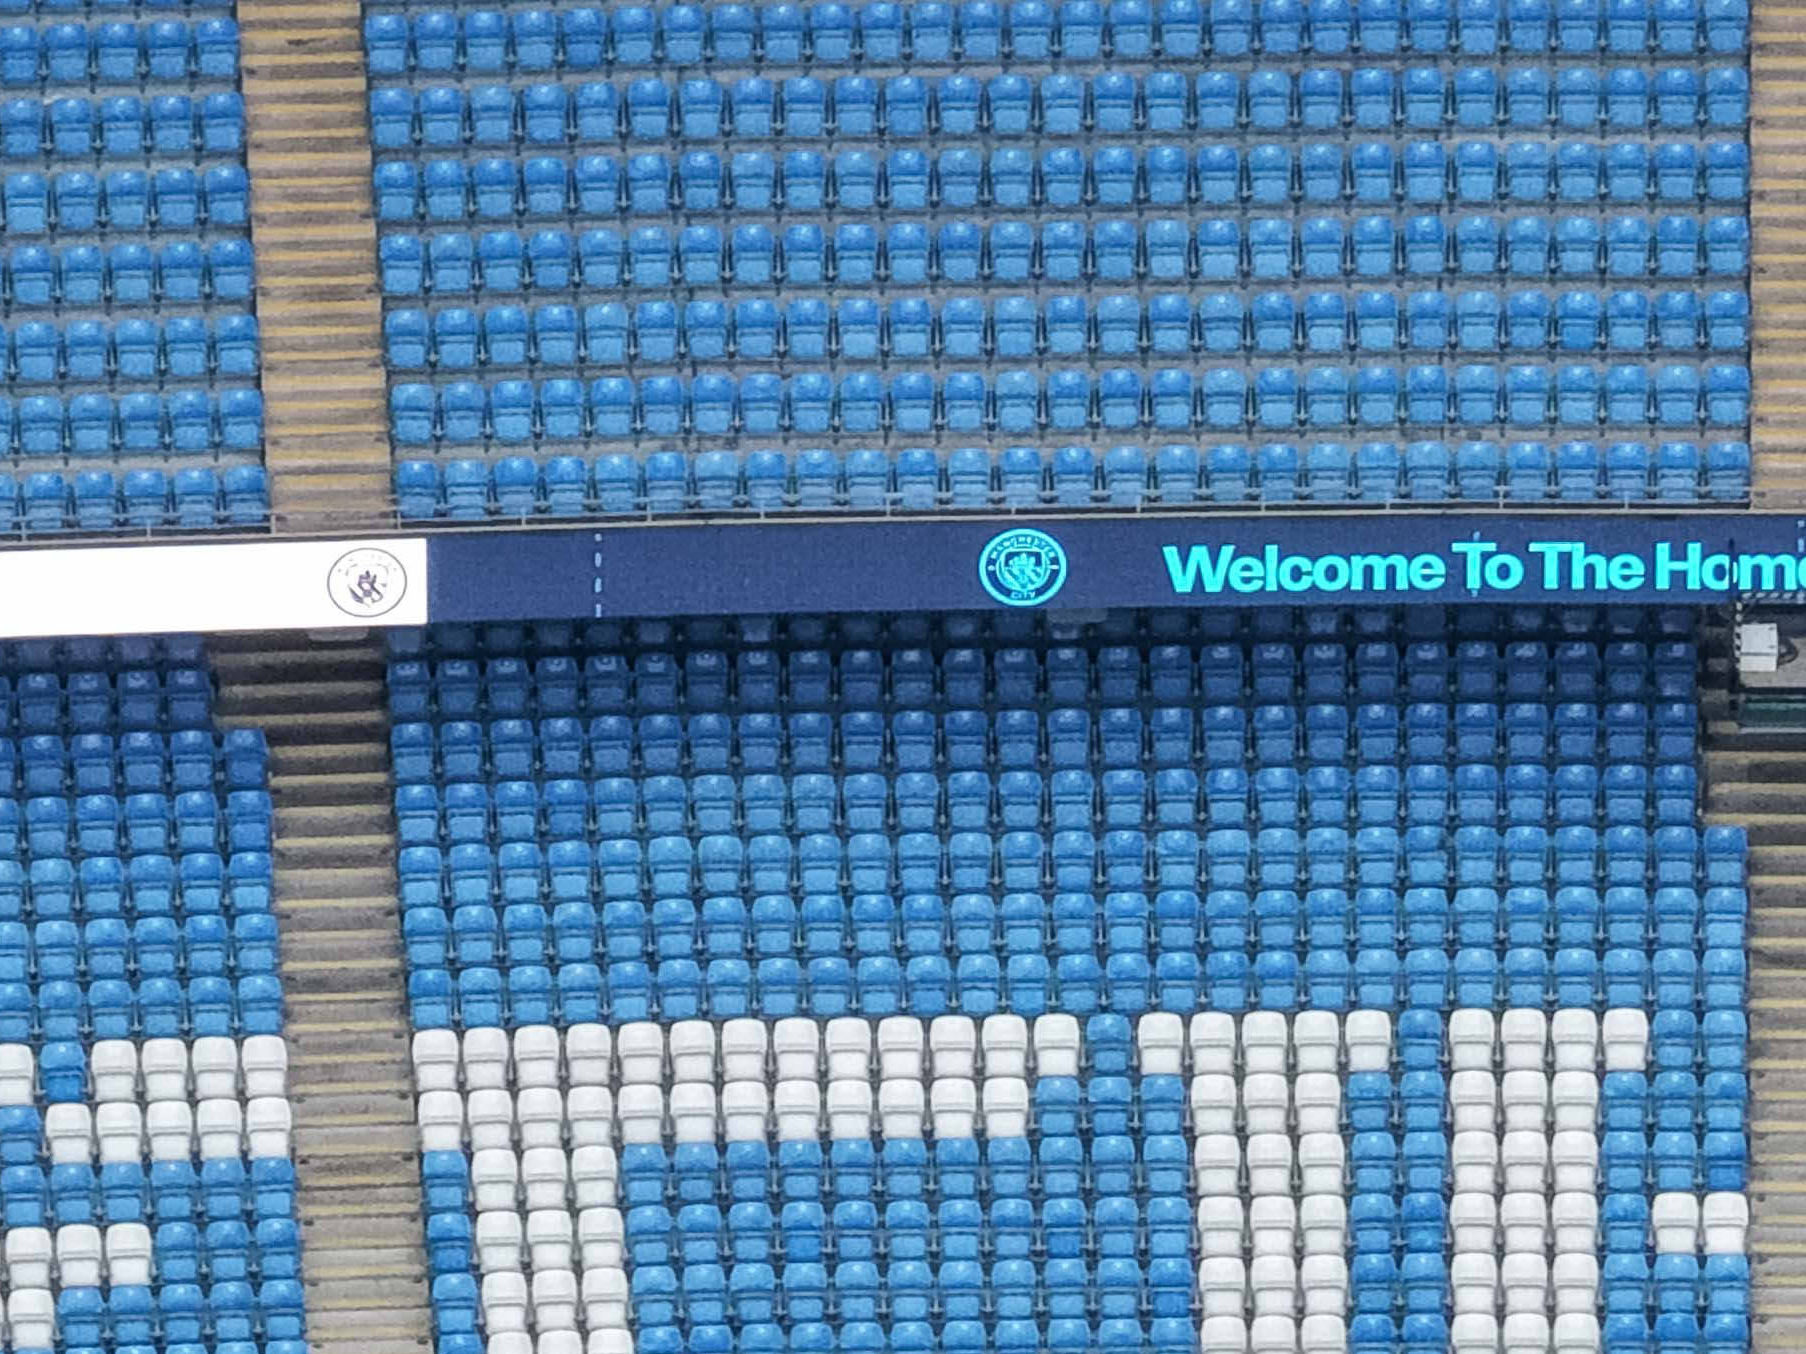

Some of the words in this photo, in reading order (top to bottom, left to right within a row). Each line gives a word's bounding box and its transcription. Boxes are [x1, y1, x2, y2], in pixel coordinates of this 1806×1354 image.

[1162, 544, 1446, 593] Welcome
[1451, 543, 1524, 590] To
[1528, 541, 1645, 590] The
